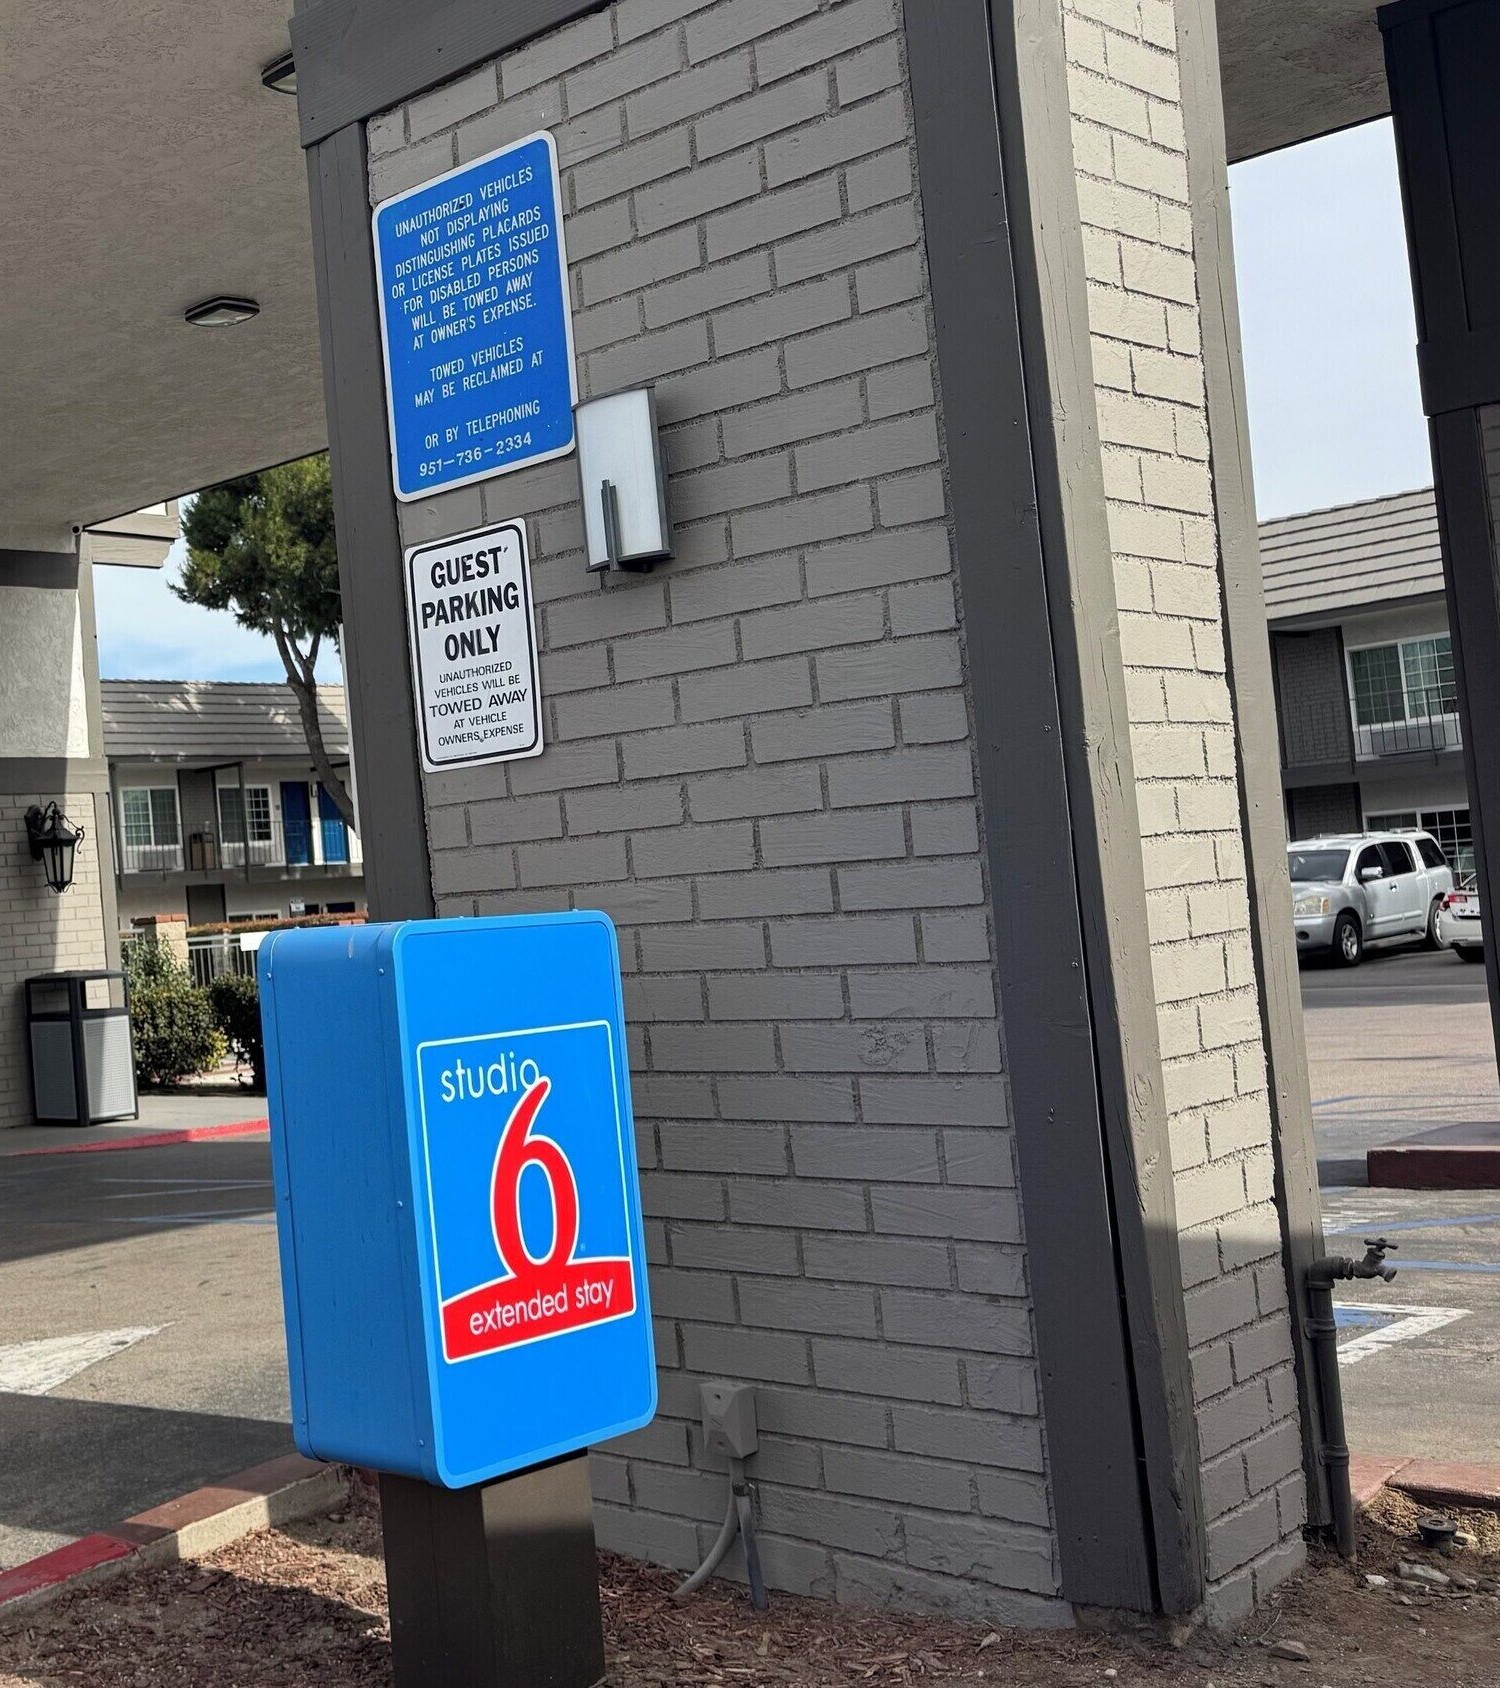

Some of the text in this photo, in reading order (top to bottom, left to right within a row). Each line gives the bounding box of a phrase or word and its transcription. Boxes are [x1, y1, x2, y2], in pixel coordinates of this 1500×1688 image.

[395, 166, 533, 238] UNAUTHORIZED VEHICLES
[420, 198, 509, 247] NOT DISPLAYING
[391, 224, 549, 299] OR LICENSE PLATES ISSUED
[395, 206, 541, 278] DISTINGUISHING PLACARDS
[403, 249, 539, 315] FOR DISABLED PERSONS
[412, 272, 533, 331] WILL BE TOWED AWAY
[413, 293, 537, 351] AT OWNER'S EXPENSE.
[414, 350, 544, 408] MAY BE RECLAIMED AT
[430, 337, 524, 382] TOWED VEHICLES
[425, 400, 541, 450] OR BY TELEPHONING
[430, 546, 502, 589] GUEST
[421, 581, 520, 629] PARKING
[444, 624, 501, 661] ONLY
[434, 674, 521, 699] VEHICLES WILL BE
[439, 660, 512, 683] UNAUTHORIZED
[429, 688, 528, 718] TOWED AWAY
[453, 711, 507, 729] AT VEHICLE
[438, 723, 524, 747] OWNERS EXPENSE
[441, 1051, 540, 1103] studio
[490, 1076, 580, 1275] 6
[469, 1278, 614, 1336] extended stay
